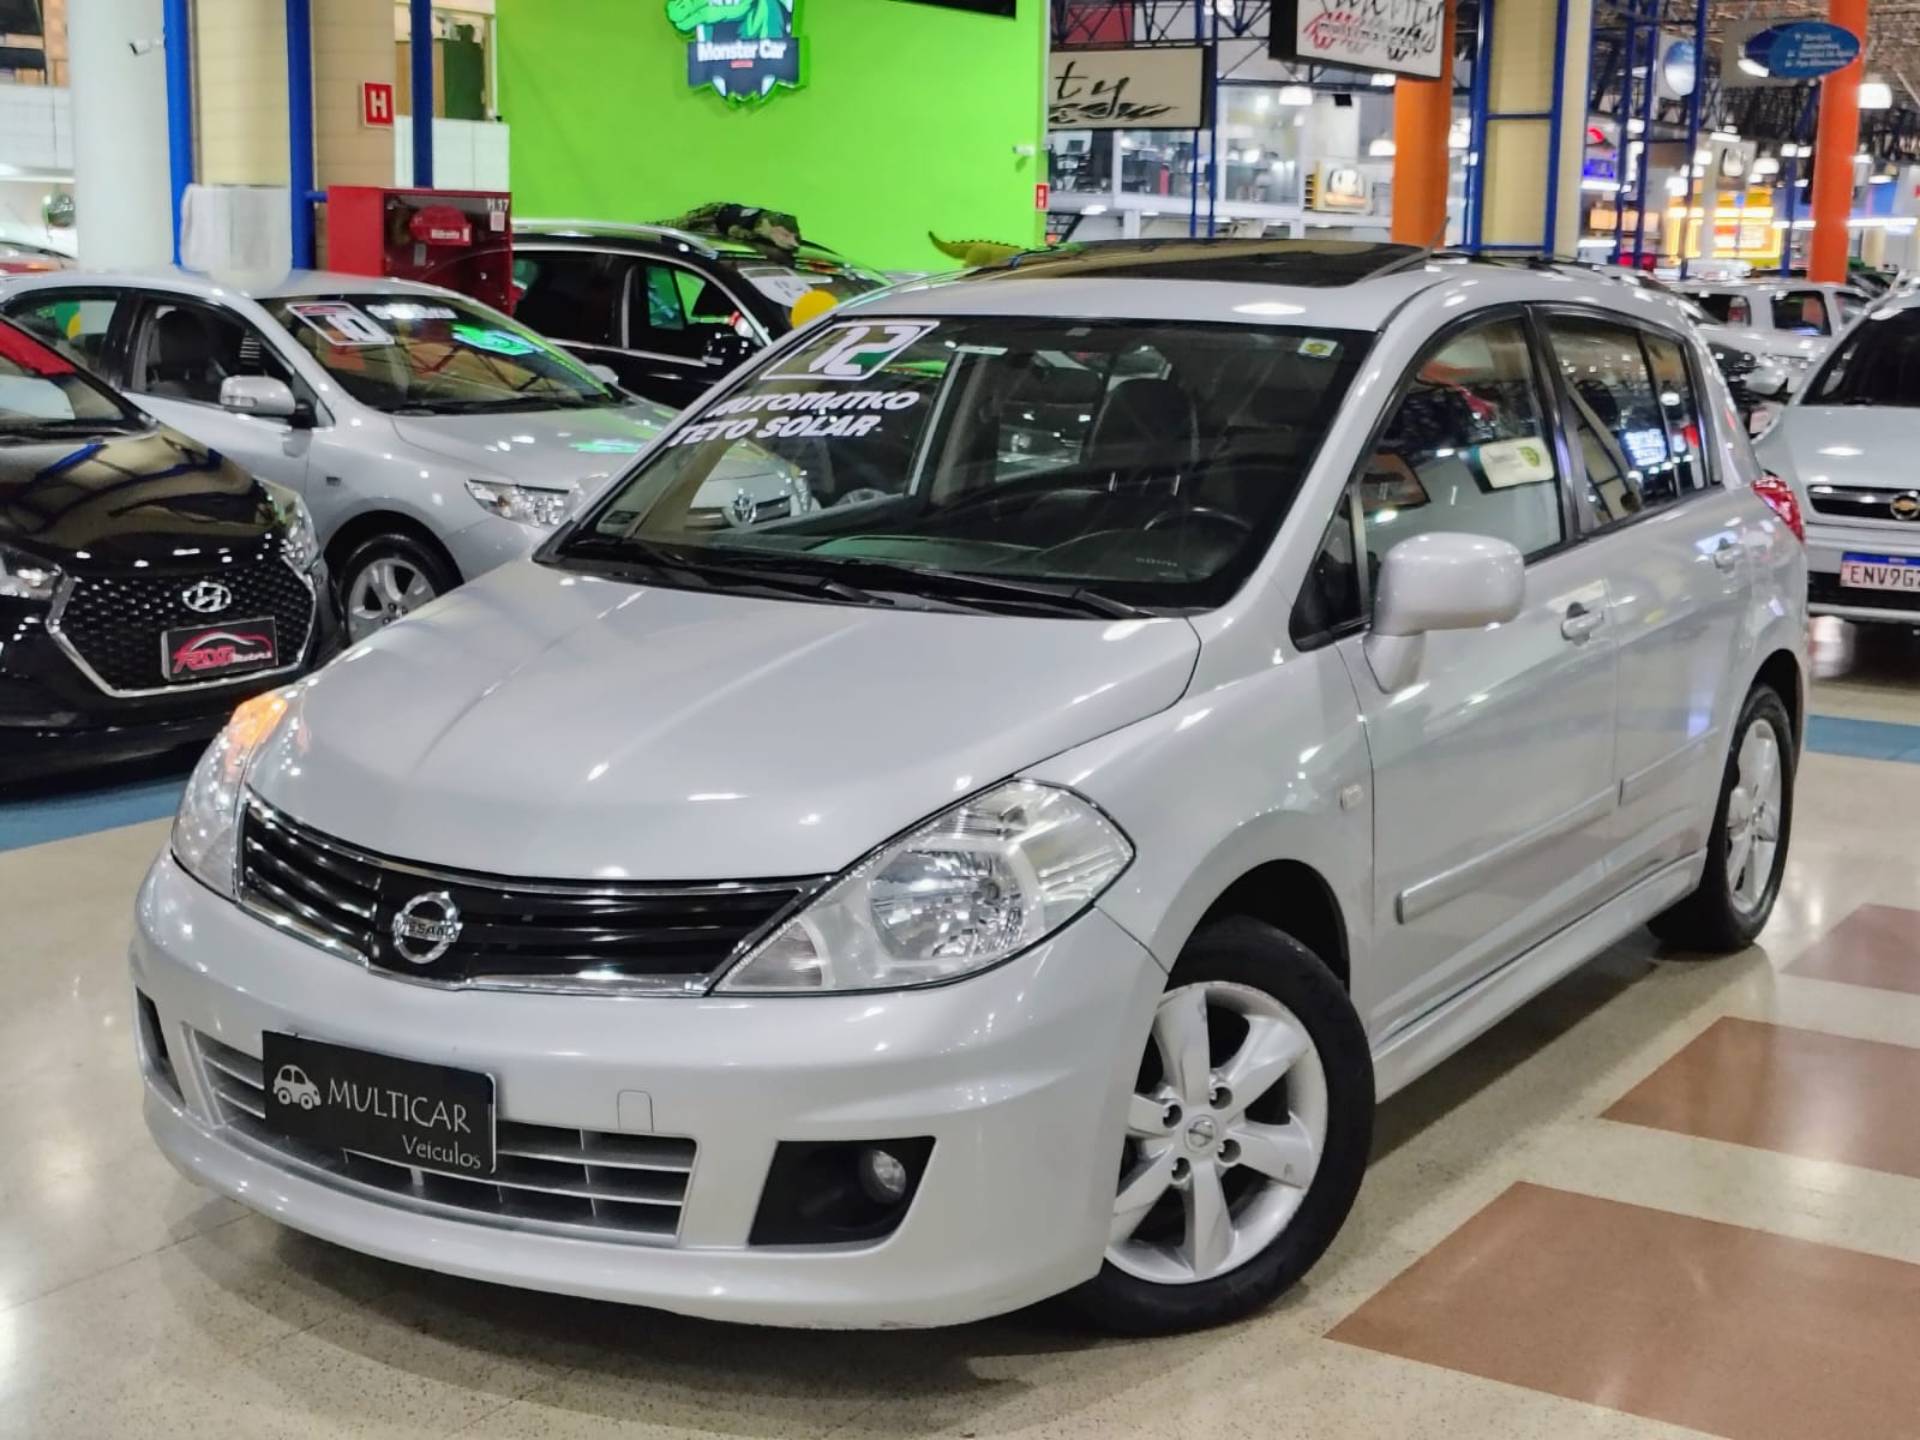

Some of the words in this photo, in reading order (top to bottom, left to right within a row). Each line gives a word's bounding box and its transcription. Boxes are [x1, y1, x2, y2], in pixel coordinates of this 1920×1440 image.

[697, 40, 758, 61] Monster
[760, 40, 787, 59] Car
[370, 89, 387, 118] H
[809, 326, 921, 375] 12
[667, 418, 758, 447] TETO
[756, 415, 882, 439] SOLAR
[328, 1077, 471, 1133] MULTICAR
